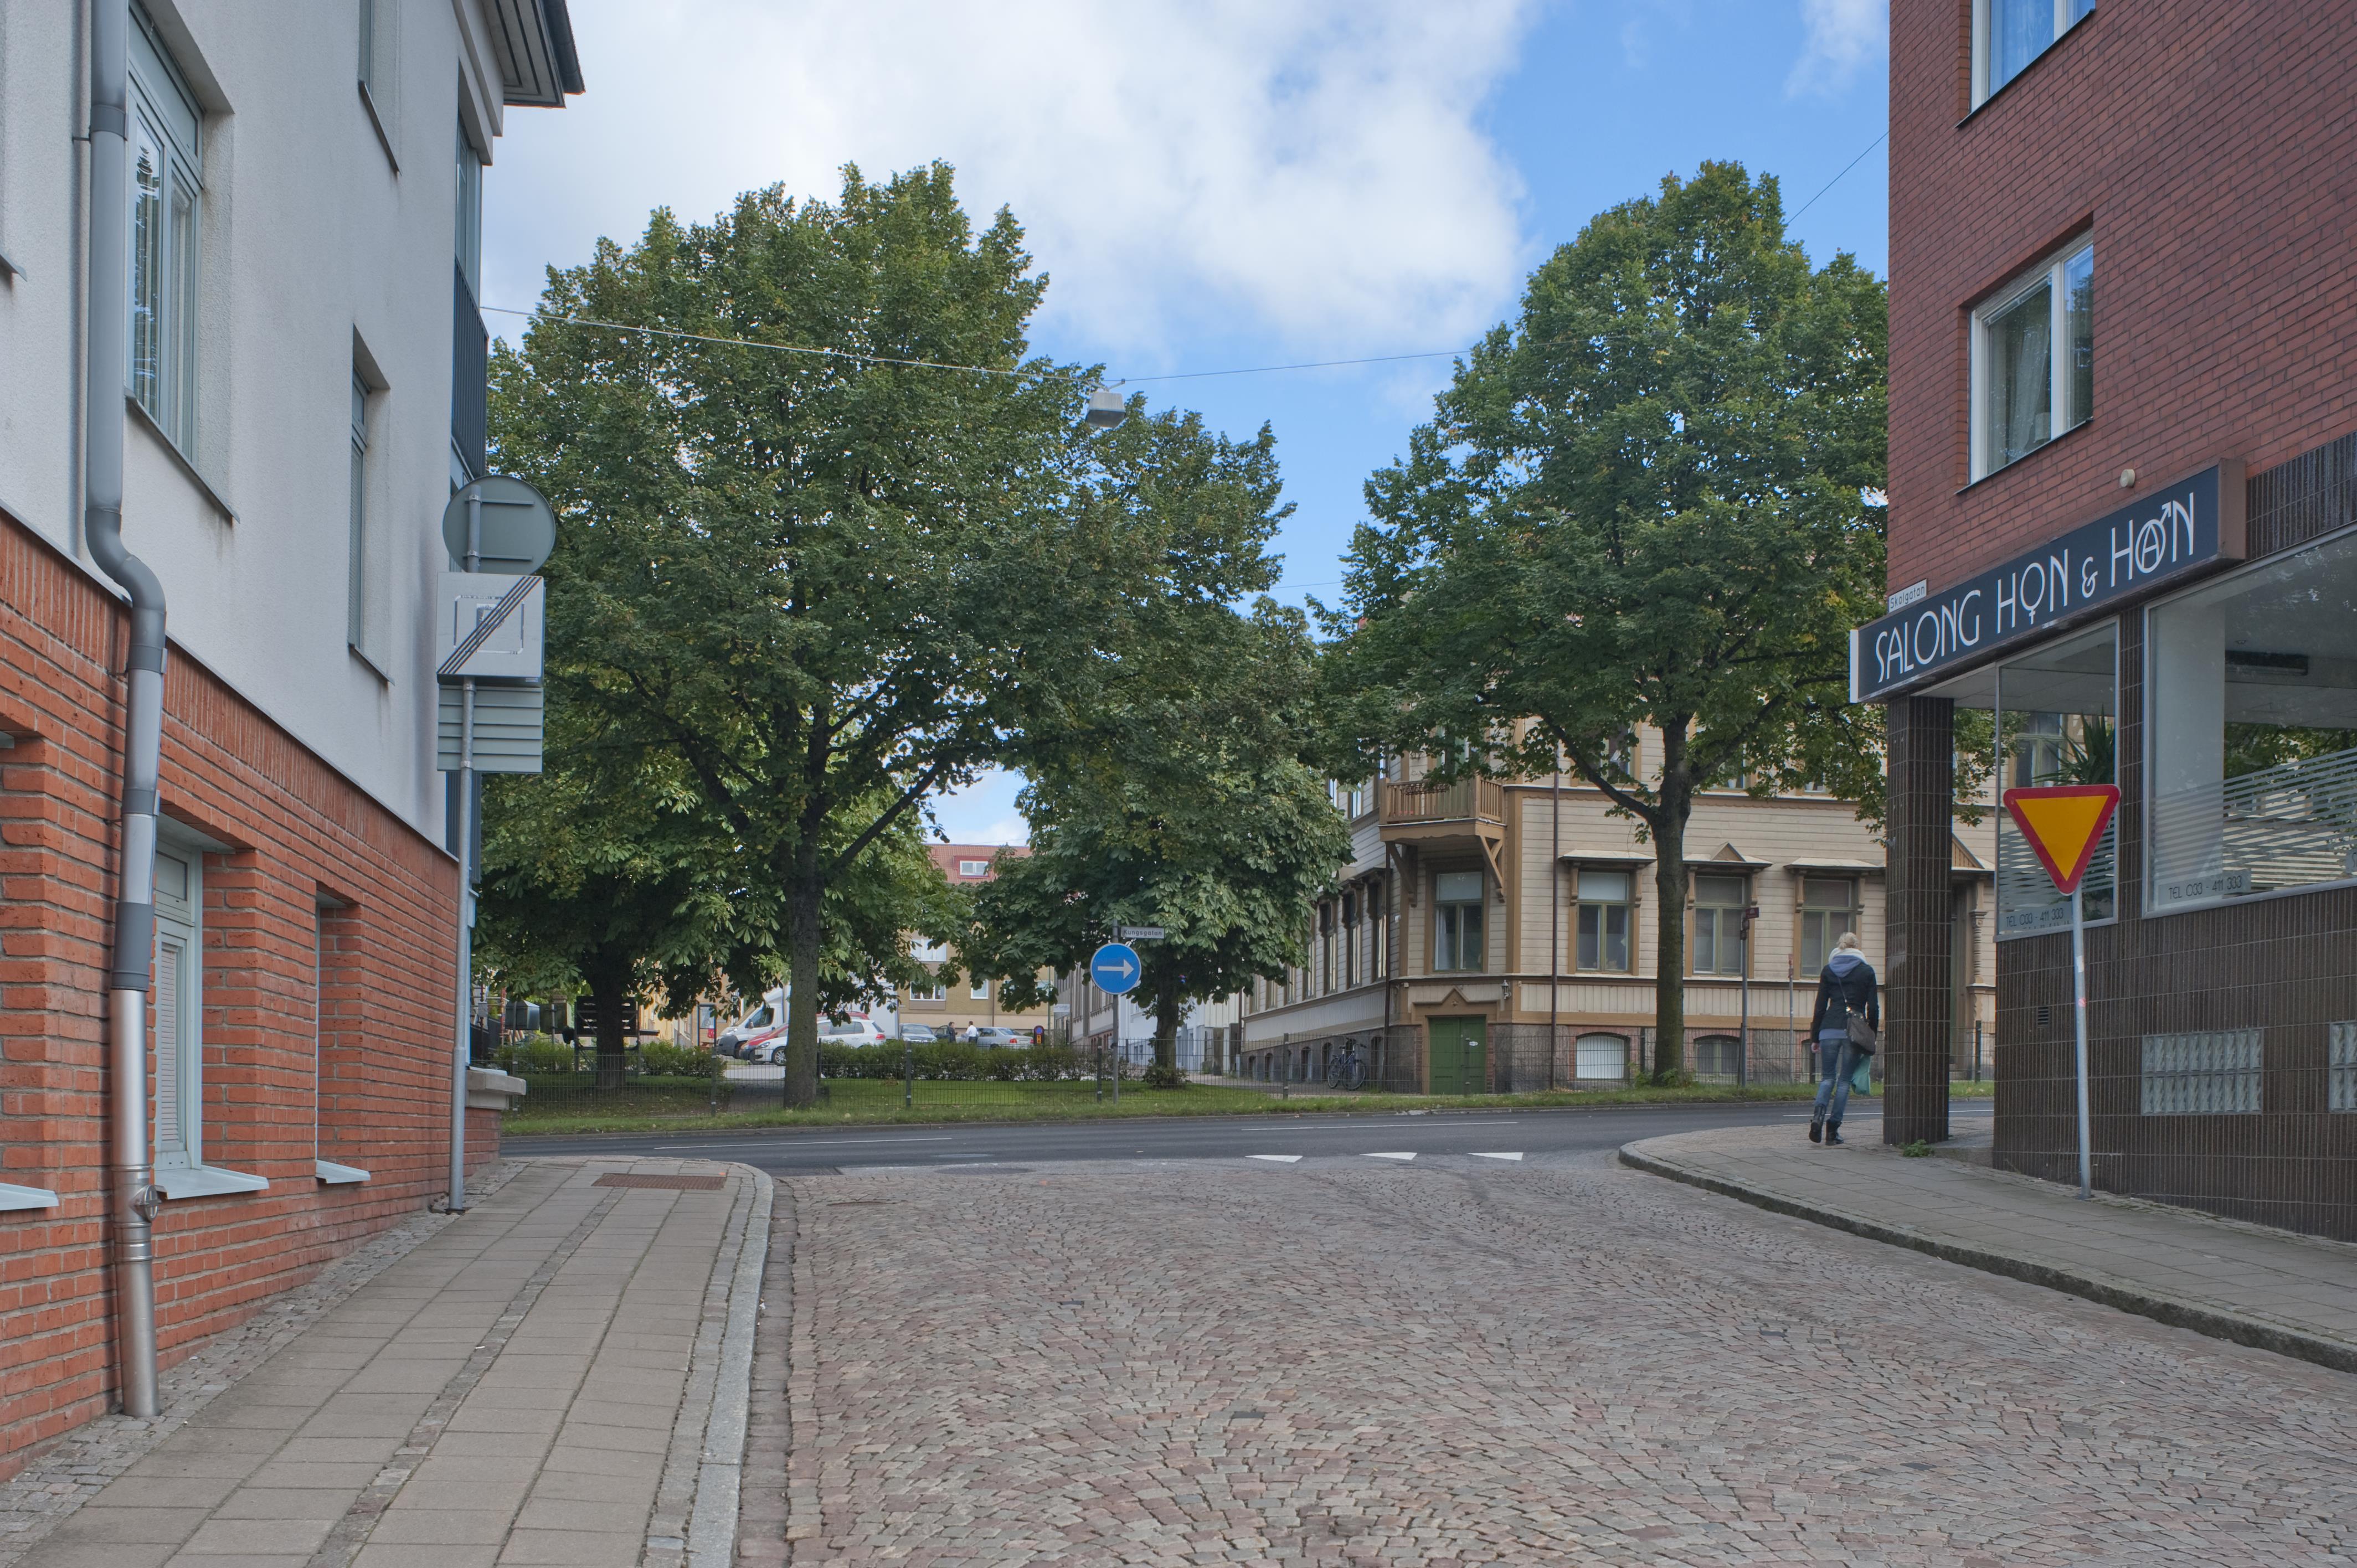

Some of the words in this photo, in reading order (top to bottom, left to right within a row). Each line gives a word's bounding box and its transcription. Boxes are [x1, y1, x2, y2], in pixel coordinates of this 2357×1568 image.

[1875, 589, 1981, 683] SALONG
[1997, 549, 2068, 634] HON
[2081, 556, 2098, 599] &
[2111, 492, 2195, 587] HAN
[1890, 586, 1925, 609] Skolgatan
[2168, 886, 2182, 900] TEL
[2185, 882, 2202, 896] 033
[2212, 879, 2224, 892] 411
[2227, 875, 2242, 890] 333
[2006, 915, 2016, 927] TEL
[2019, 912, 2033, 925] 033
[2039, 910, 2049, 921] 411
[2051, 907, 2064, 920] 333
